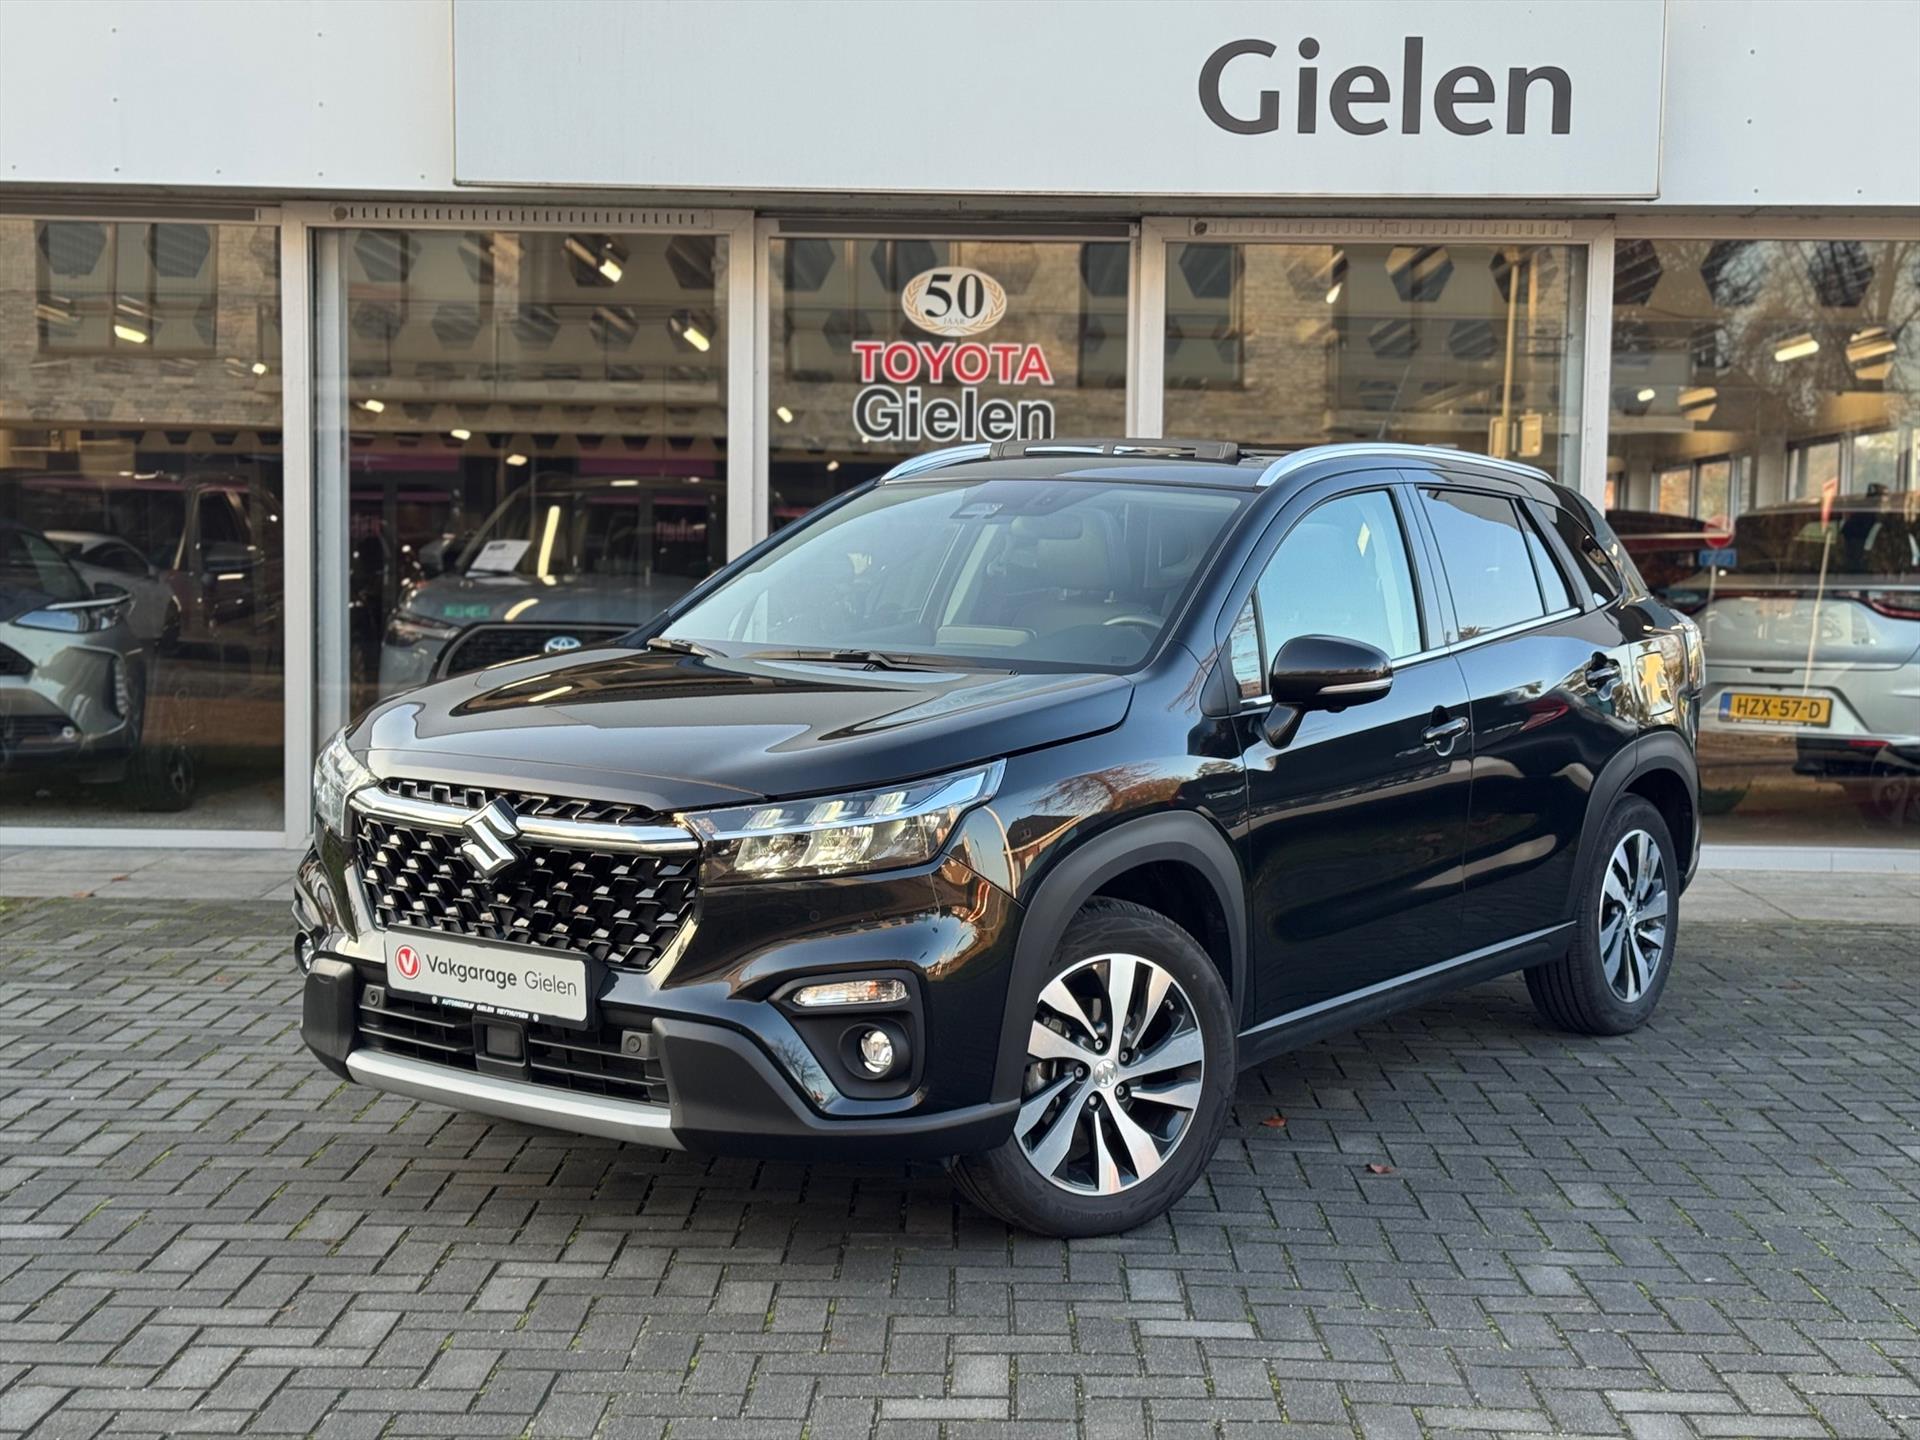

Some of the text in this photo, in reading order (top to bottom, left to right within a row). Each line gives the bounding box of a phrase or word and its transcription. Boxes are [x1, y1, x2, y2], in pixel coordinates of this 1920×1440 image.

[1198, 36, 1572, 136] Gielen
[925, 273, 984, 319] 50
[853, 342, 1053, 385] TOYOTA
[854, 385, 1054, 442] Gielen
[1736, 698, 1821, 720] HZX-57-D
[426, 953, 577, 997] Vakgarage Gielen
